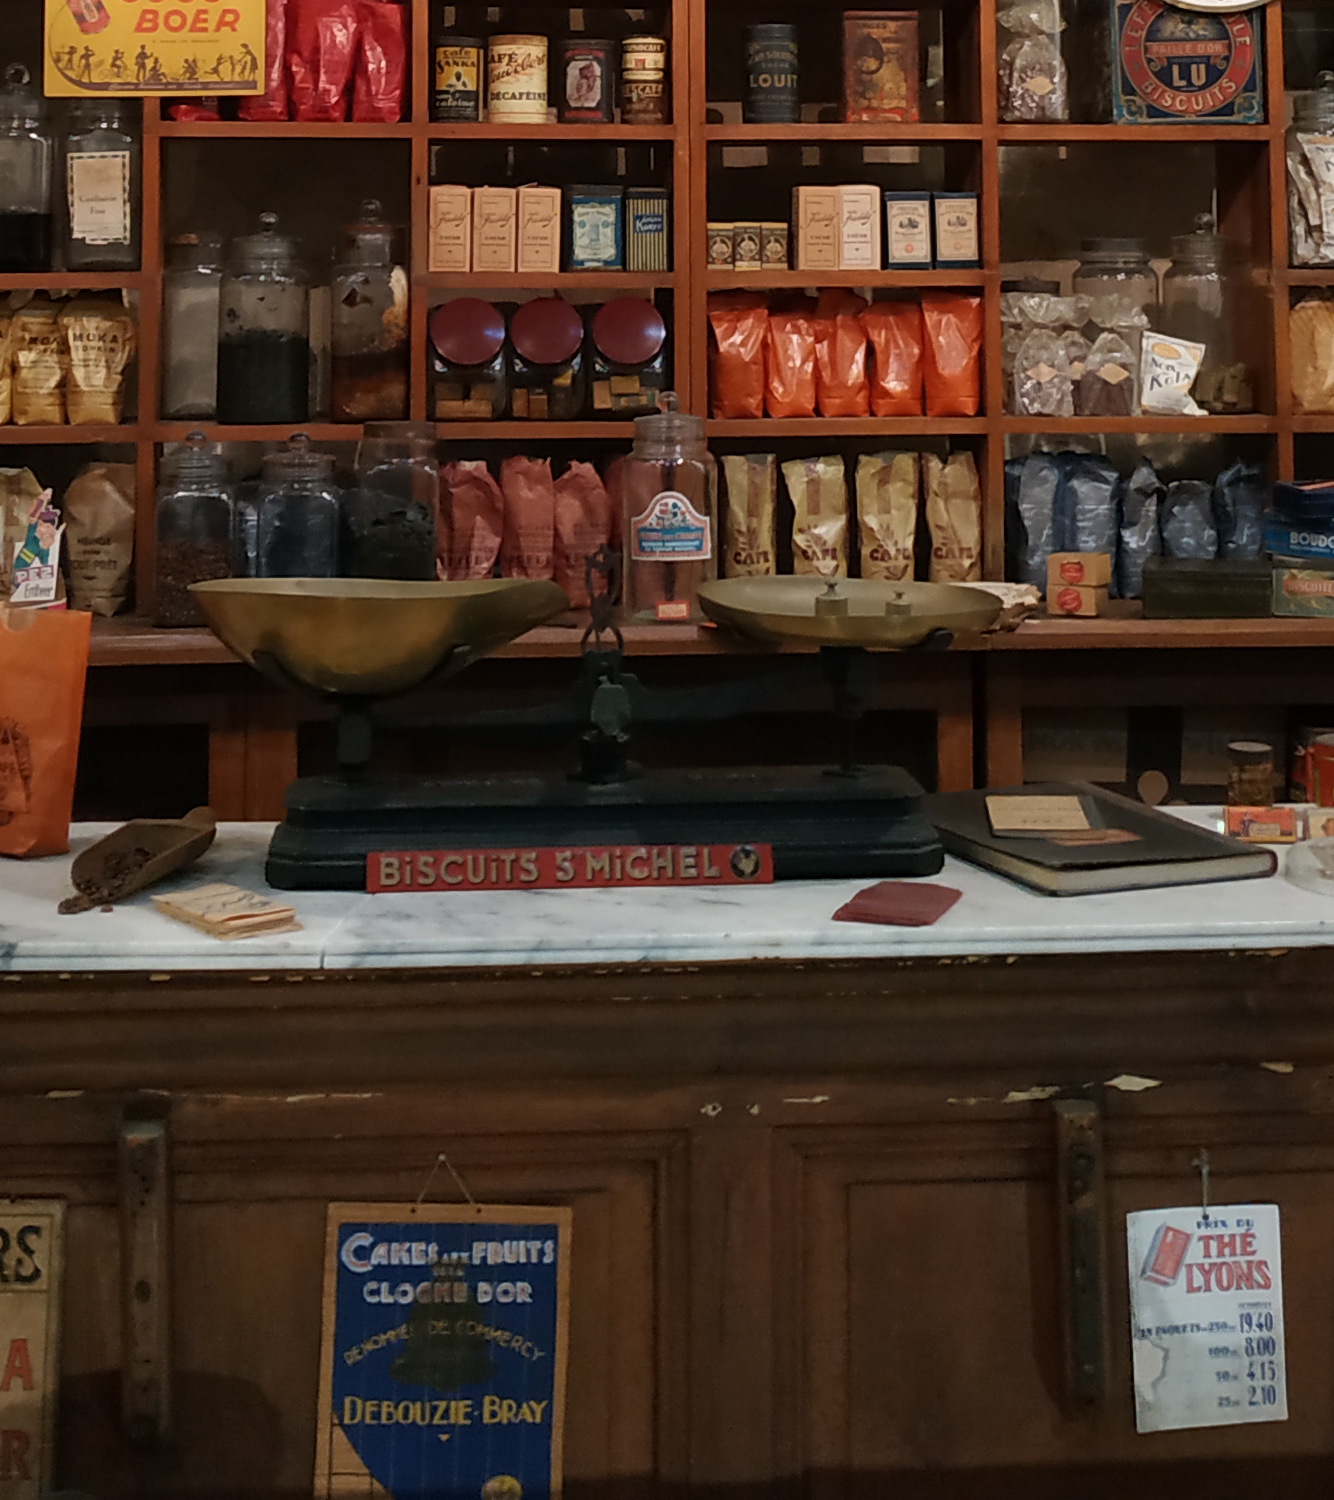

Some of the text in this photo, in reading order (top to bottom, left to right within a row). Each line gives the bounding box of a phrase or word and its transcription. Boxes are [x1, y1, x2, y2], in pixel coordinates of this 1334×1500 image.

[133, 8, 242, 34] BOER
[1171, 62, 1207, 87] LU
[1140, 76, 1237, 112] BISCUITS
[72, 332, 119, 345] MOKA
[14, 564, 56, 584] PEZ
[340, 1231, 556, 1274] CAKES FRUITS
[1198, 1228, 1259, 1260] THÉ
[1183, 1258, 1273, 1295] LYONS
[363, 1280, 468, 1305] CLOCHE
